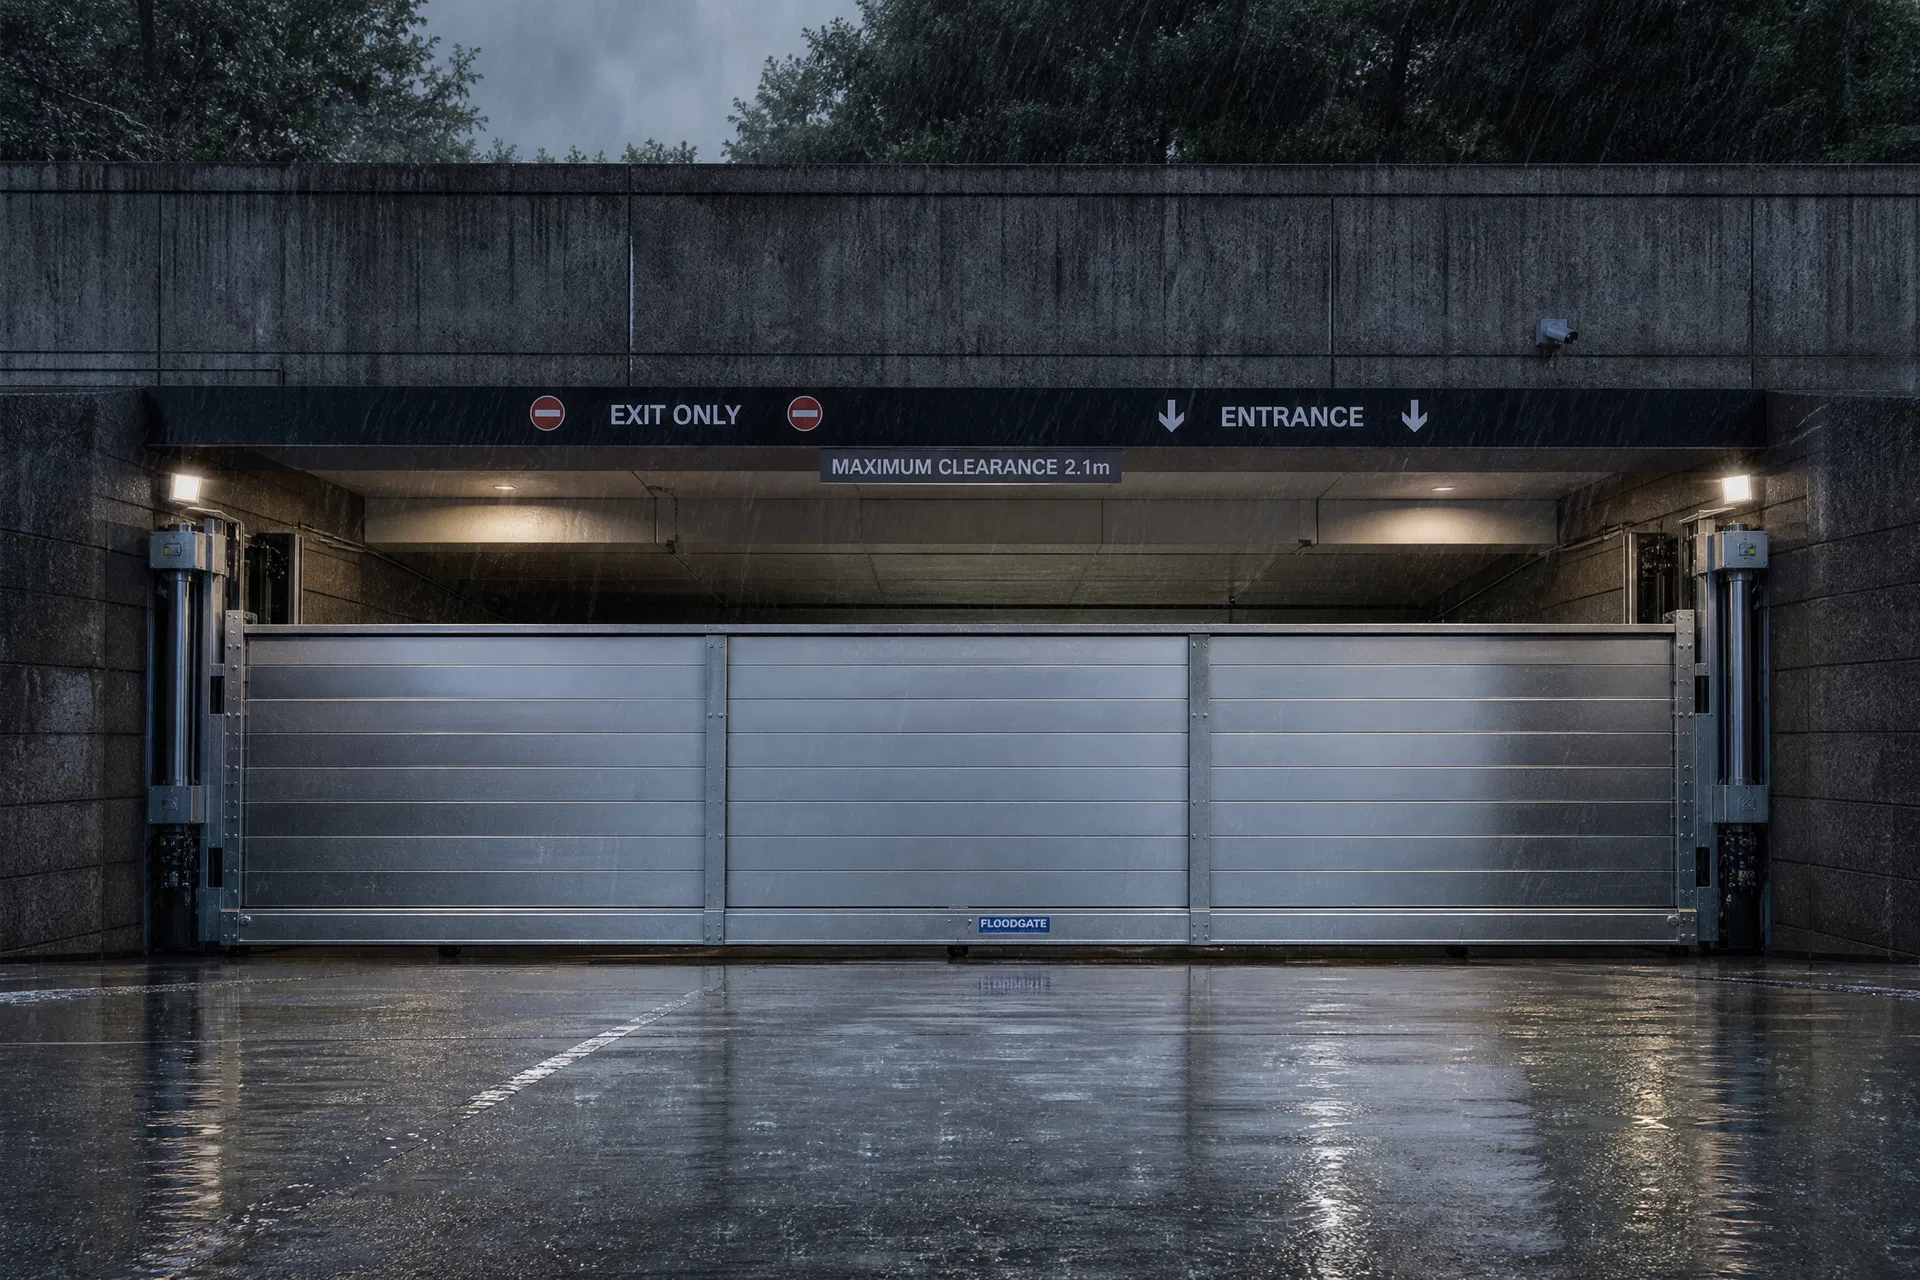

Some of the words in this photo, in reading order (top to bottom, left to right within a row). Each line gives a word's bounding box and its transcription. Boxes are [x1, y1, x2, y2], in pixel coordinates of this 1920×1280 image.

[610, 404, 666, 425] EXIT
[673, 404, 742, 426] ONLY
[1221, 406, 1364, 427] ENTRANCE
[832, 458, 932, 475] MAXIMUM
[938, 458, 1058, 476] CLEARANCE
[1064, 458, 1110, 475] 2.1m
[980, 918, 1047, 928] FLOODGATE
